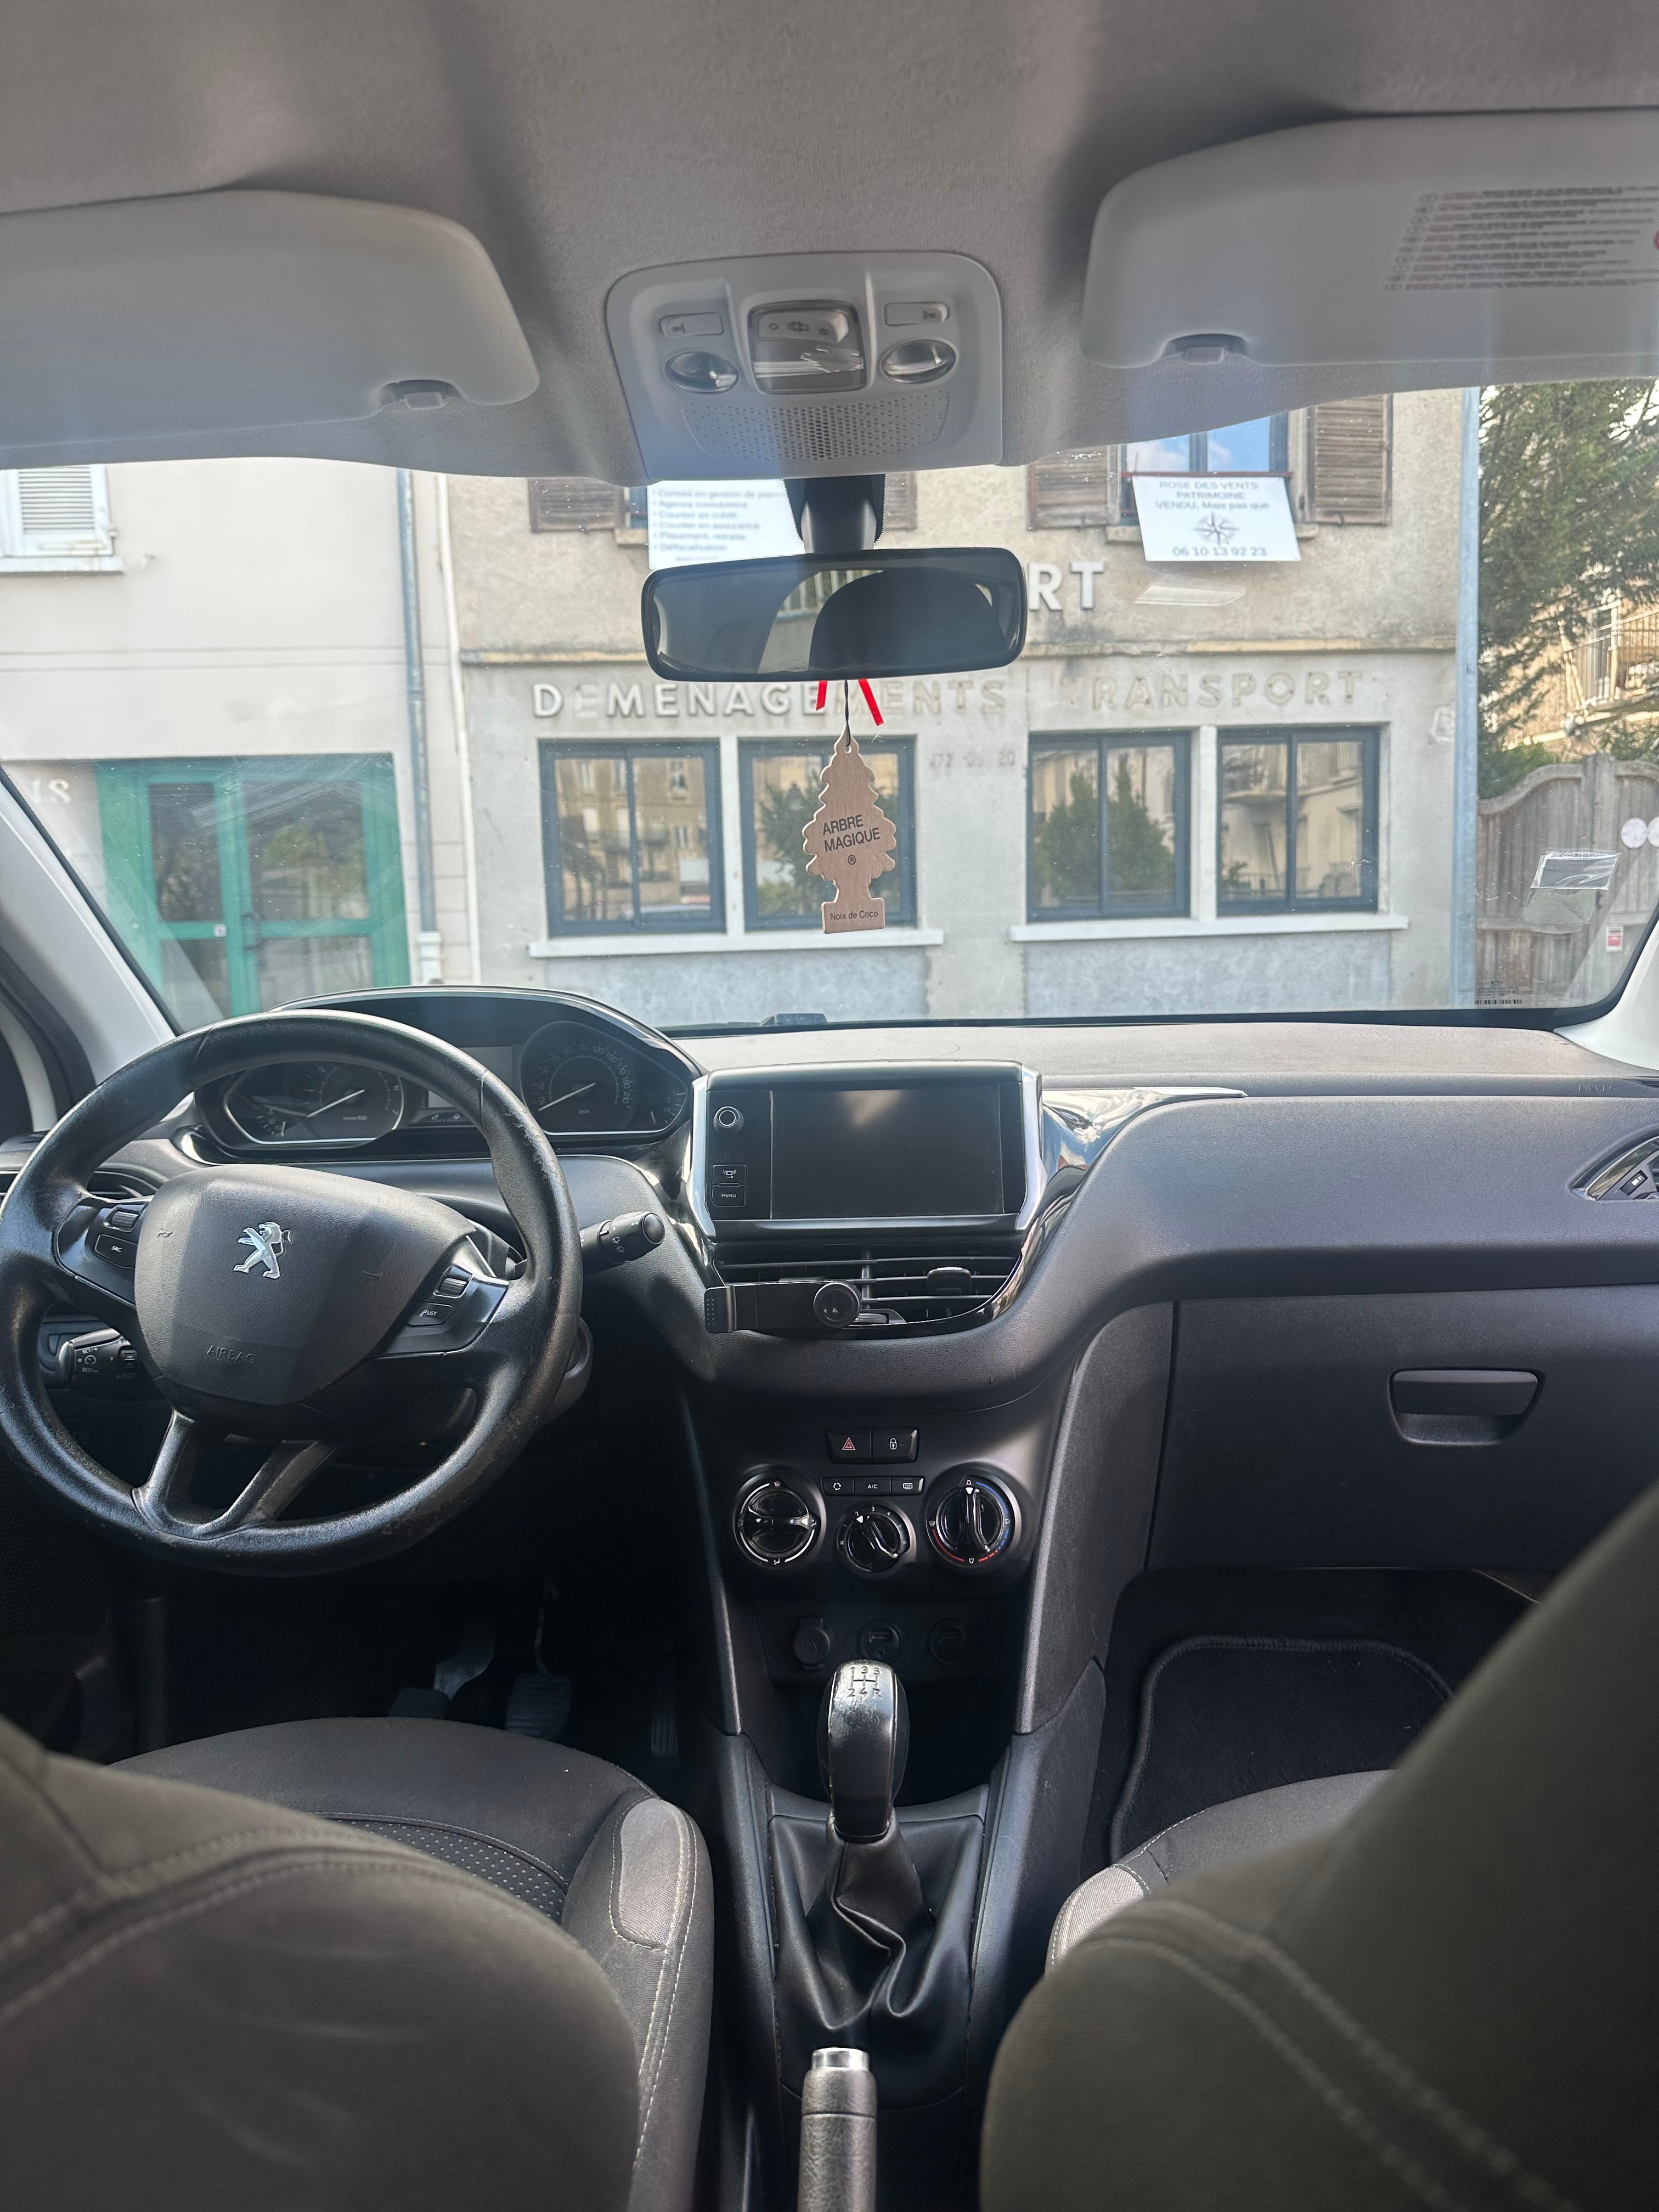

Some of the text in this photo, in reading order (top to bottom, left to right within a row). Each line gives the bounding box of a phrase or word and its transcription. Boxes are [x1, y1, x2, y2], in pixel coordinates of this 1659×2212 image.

[1159, 481, 1259, 490] ROSE DES VENTS
[1176, 491, 1246, 500] PATRIMOINE
[1172, 547, 1189, 556] 06
[1194, 547, 1207, 556] 10
[1213, 548, 1227, 556] 13
[1250, 548, 1267, 556] 23
[822, 814, 864, 836] ARBRE
[823, 827, 881, 853] MAGIQUE
[830, 910, 878, 921] Noix de Coco
[207, 1345, 257, 1364] AIRBAG
[850, 1666, 881, 1675] 1 3 5
[847, 1688, 856, 1697] 2
[859, 1686, 868, 1696] 4
